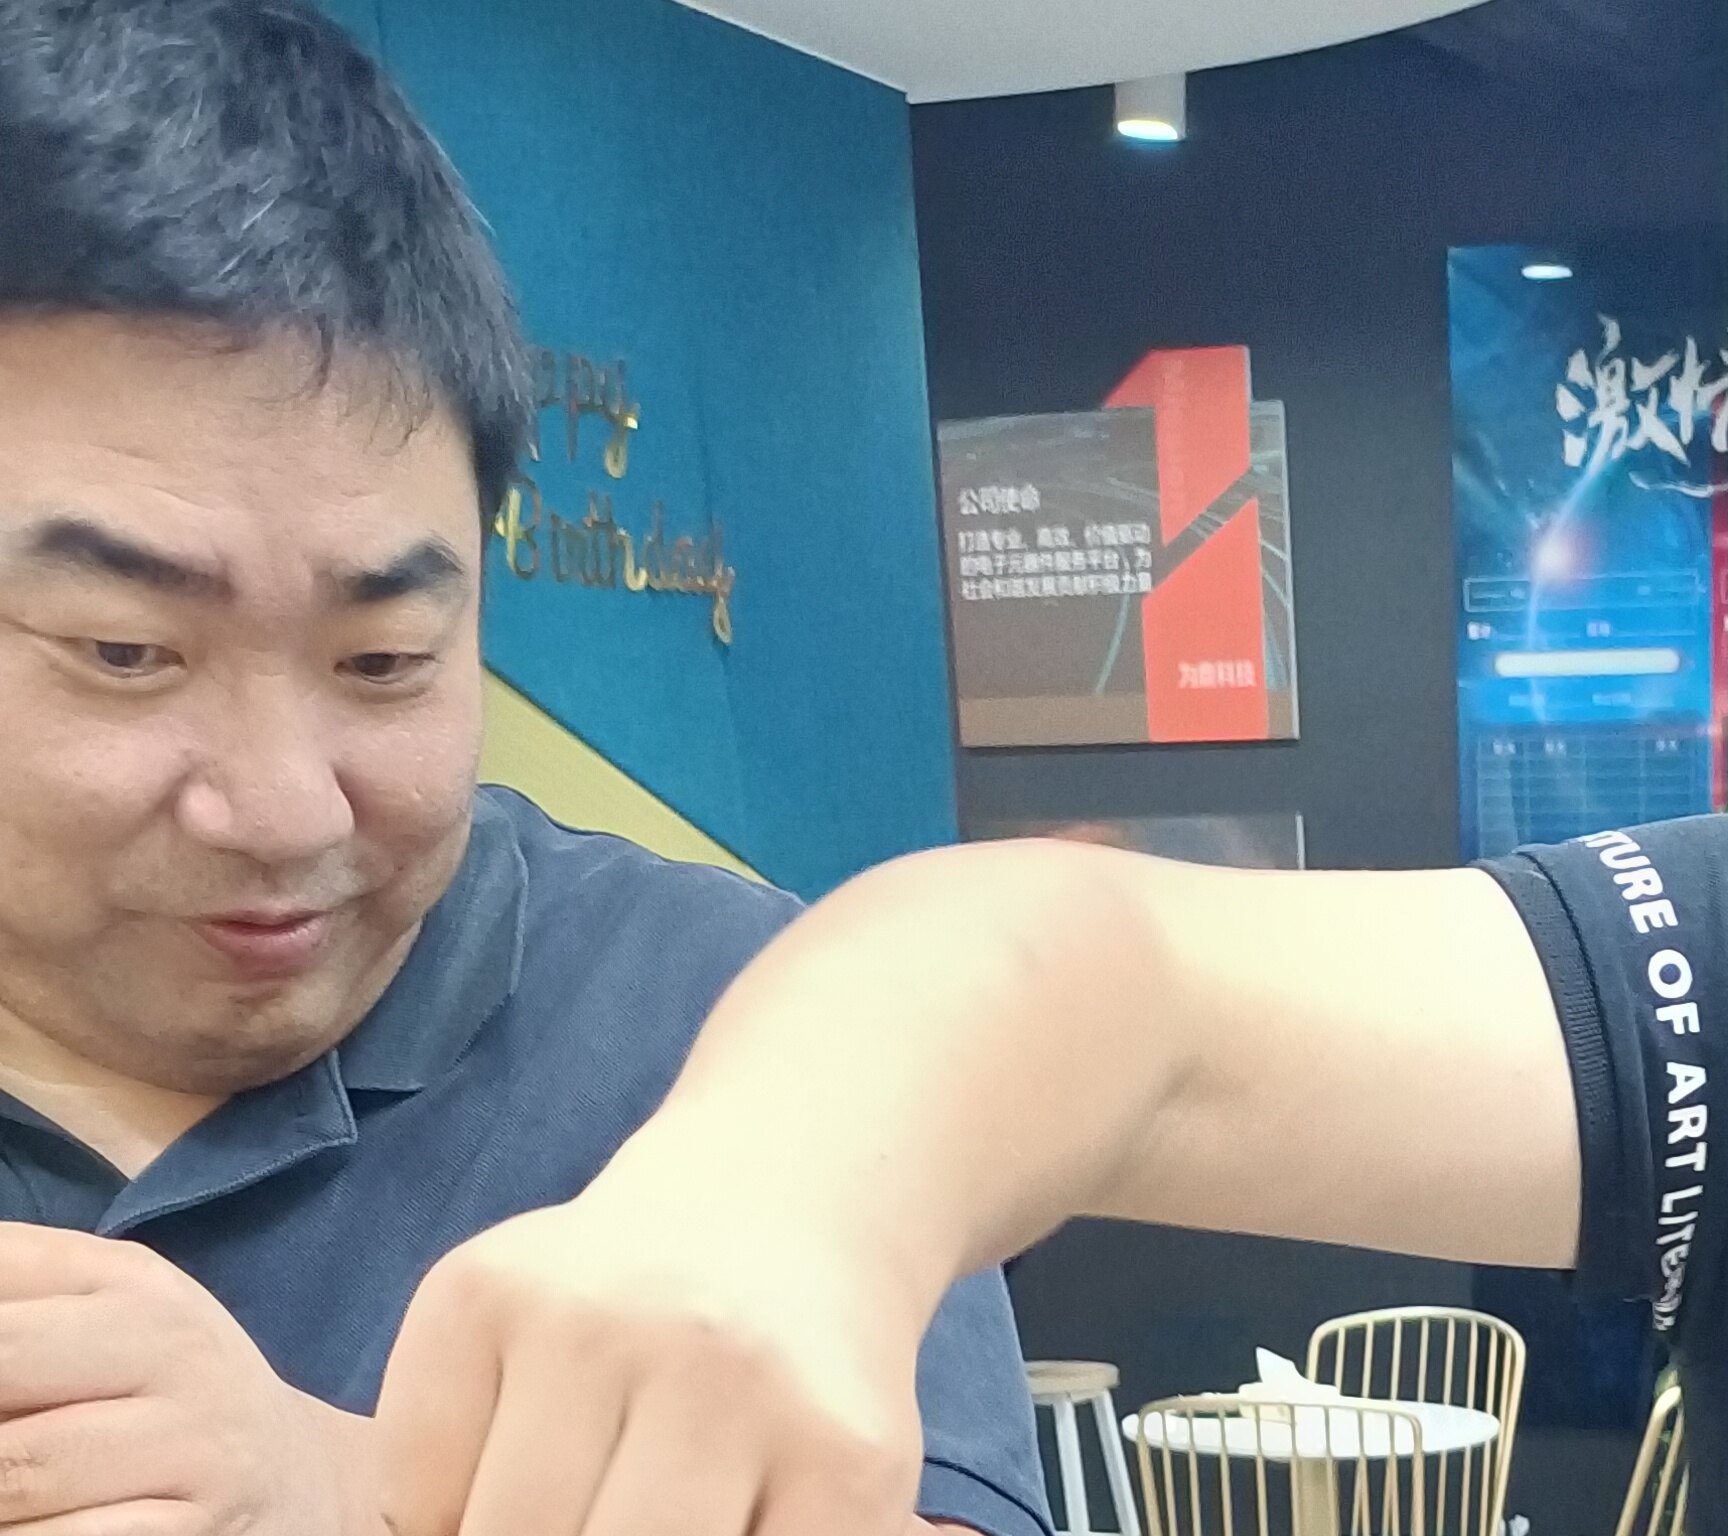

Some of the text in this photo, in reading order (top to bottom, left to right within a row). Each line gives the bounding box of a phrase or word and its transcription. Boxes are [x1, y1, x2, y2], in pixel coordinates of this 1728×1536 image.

[1576, 830, 1679, 934] TURE
[1647, 948, 1701, 1036] OF
[1664, 1062, 1708, 1172] ART
